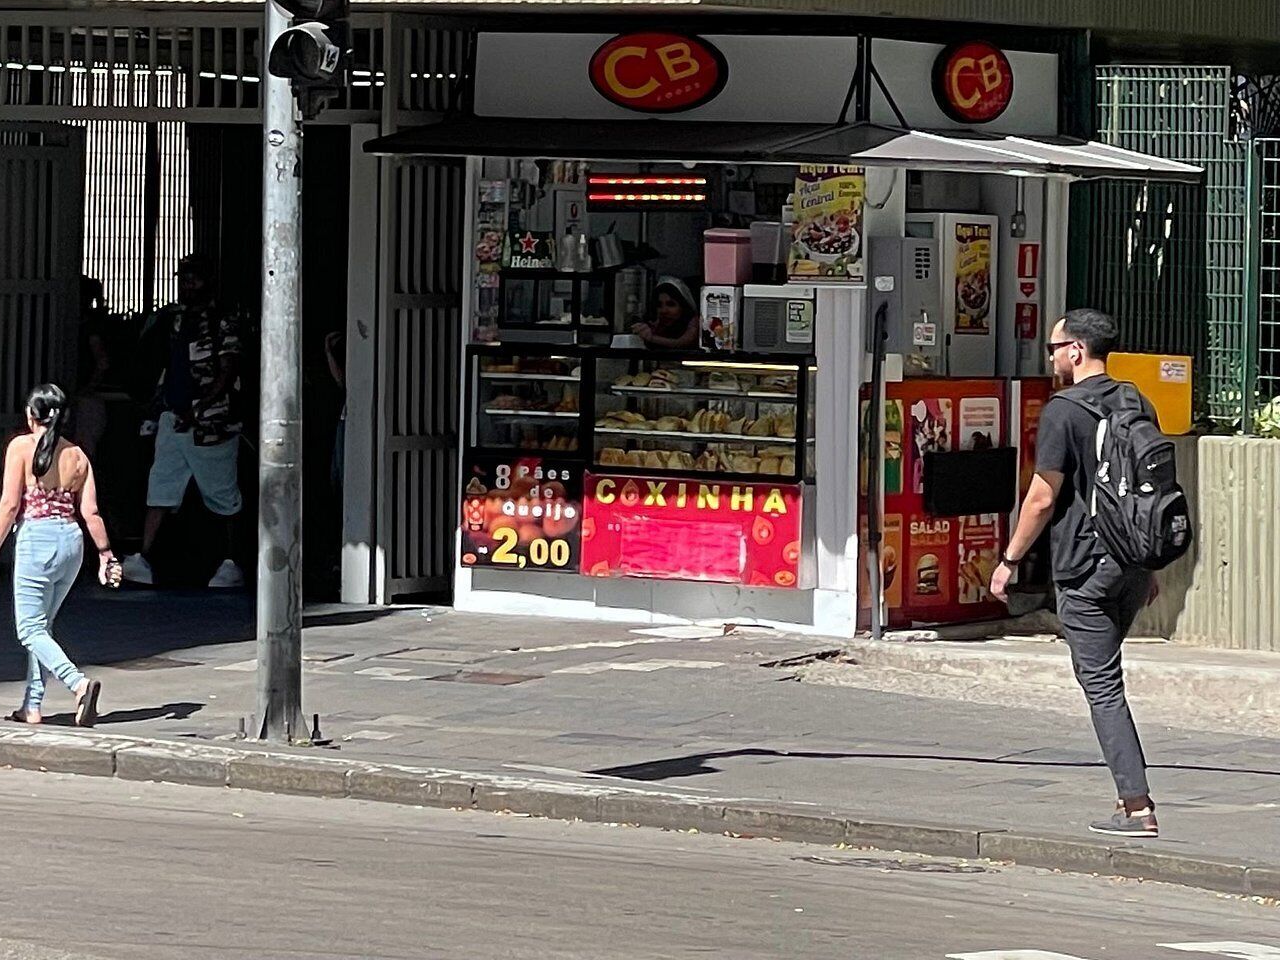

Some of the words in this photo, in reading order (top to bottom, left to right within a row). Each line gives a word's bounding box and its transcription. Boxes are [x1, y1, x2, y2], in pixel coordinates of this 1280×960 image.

[604, 42, 700, 99] CB
[496, 464, 511, 489] 8
[530, 485, 554, 498] de
[502, 501, 576, 521] Queijo
[910, 520, 950, 535] SALAD
[491, 527, 570, 568] 2,00
